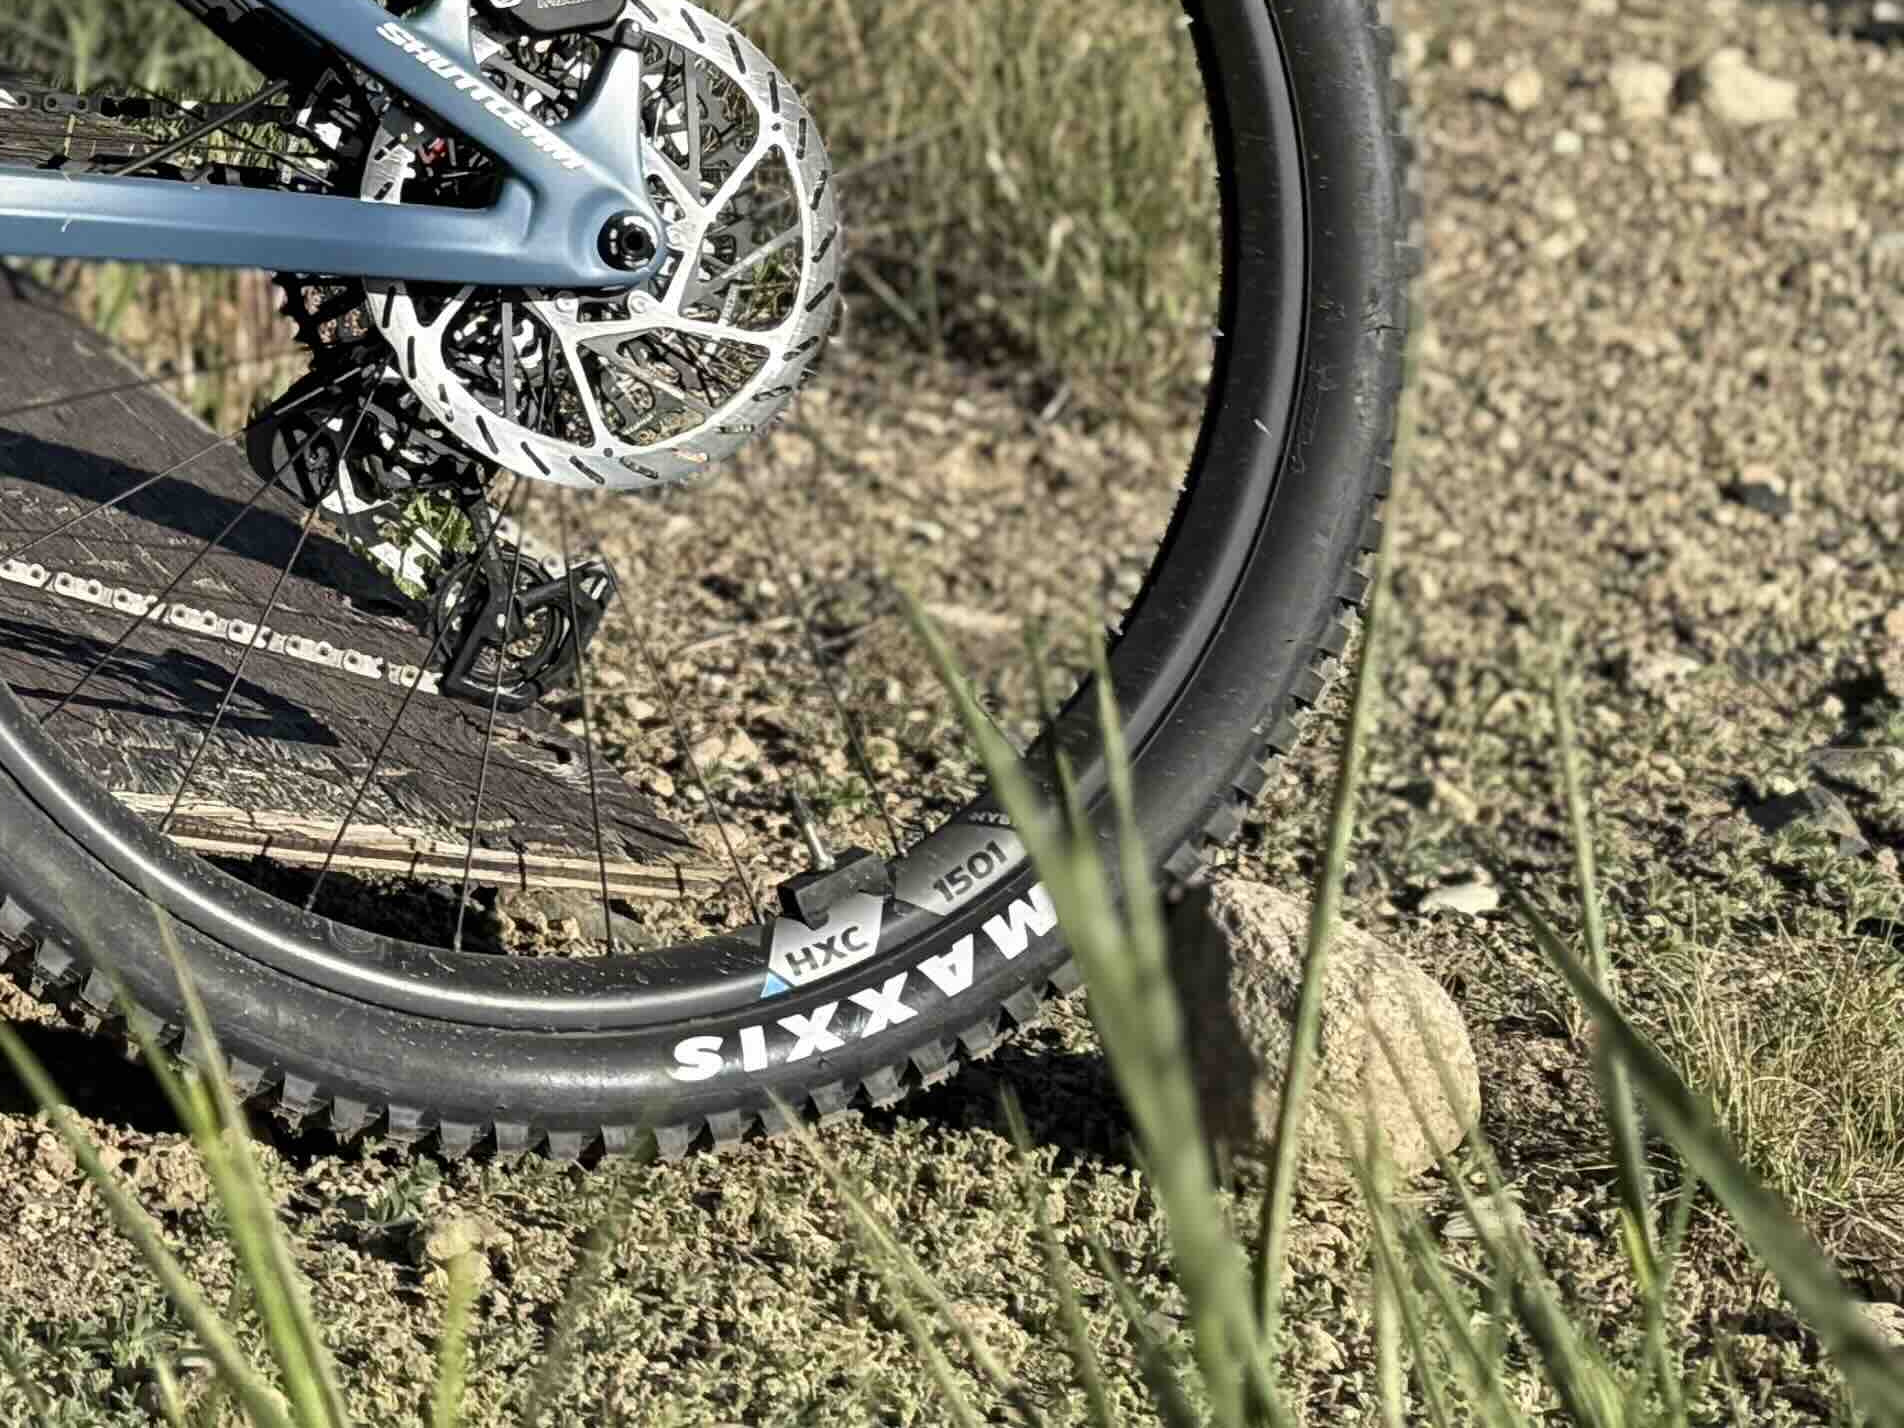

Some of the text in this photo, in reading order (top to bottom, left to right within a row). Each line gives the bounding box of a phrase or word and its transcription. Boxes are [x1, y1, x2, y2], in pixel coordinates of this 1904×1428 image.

[932, 841, 1008, 902] 1501
[669, 881, 1059, 1082] MAXXIS
[784, 926, 870, 977] HXC
